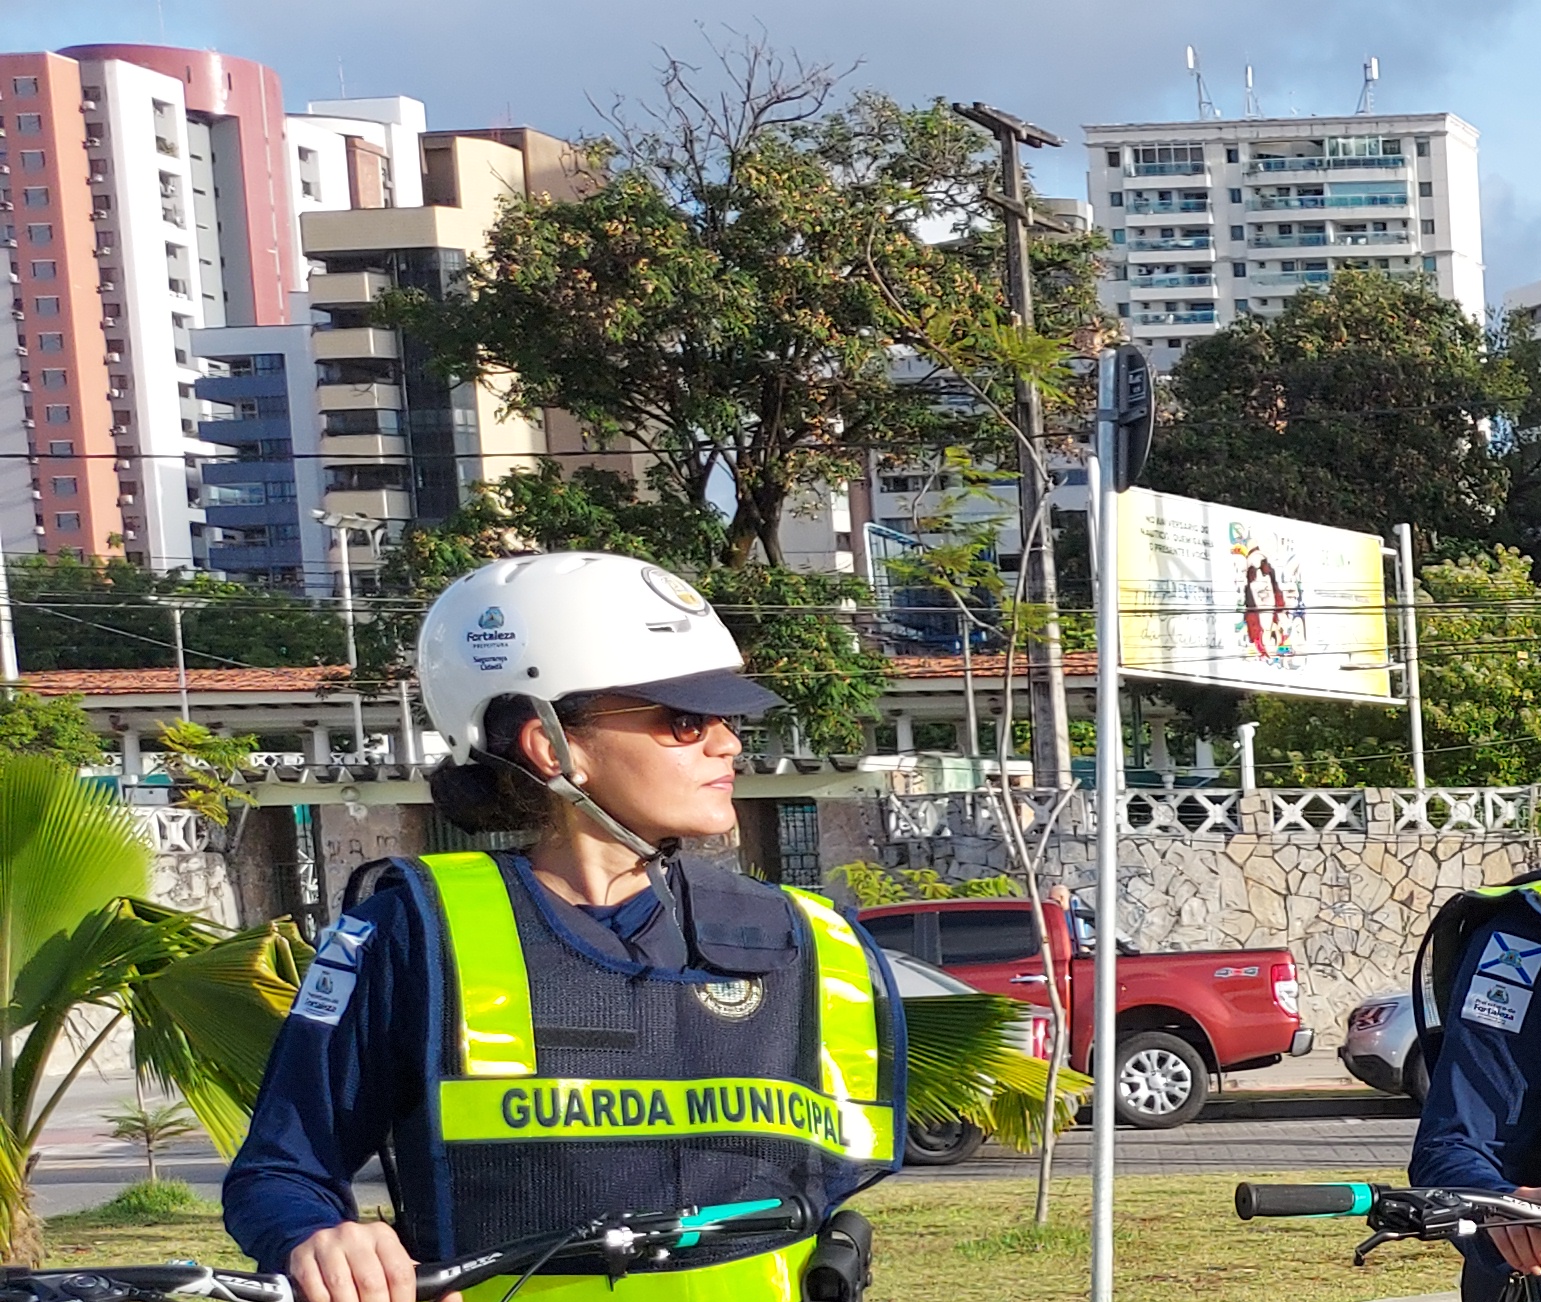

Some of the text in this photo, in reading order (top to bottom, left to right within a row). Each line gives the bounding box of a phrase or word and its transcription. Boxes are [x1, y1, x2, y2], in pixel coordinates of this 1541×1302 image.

[466, 630, 516, 642] Fortaleza
[1473, 1003, 1515, 1021] Fortaleza
[502, 1085, 851, 1148] GUARDA MUNICIPAL
